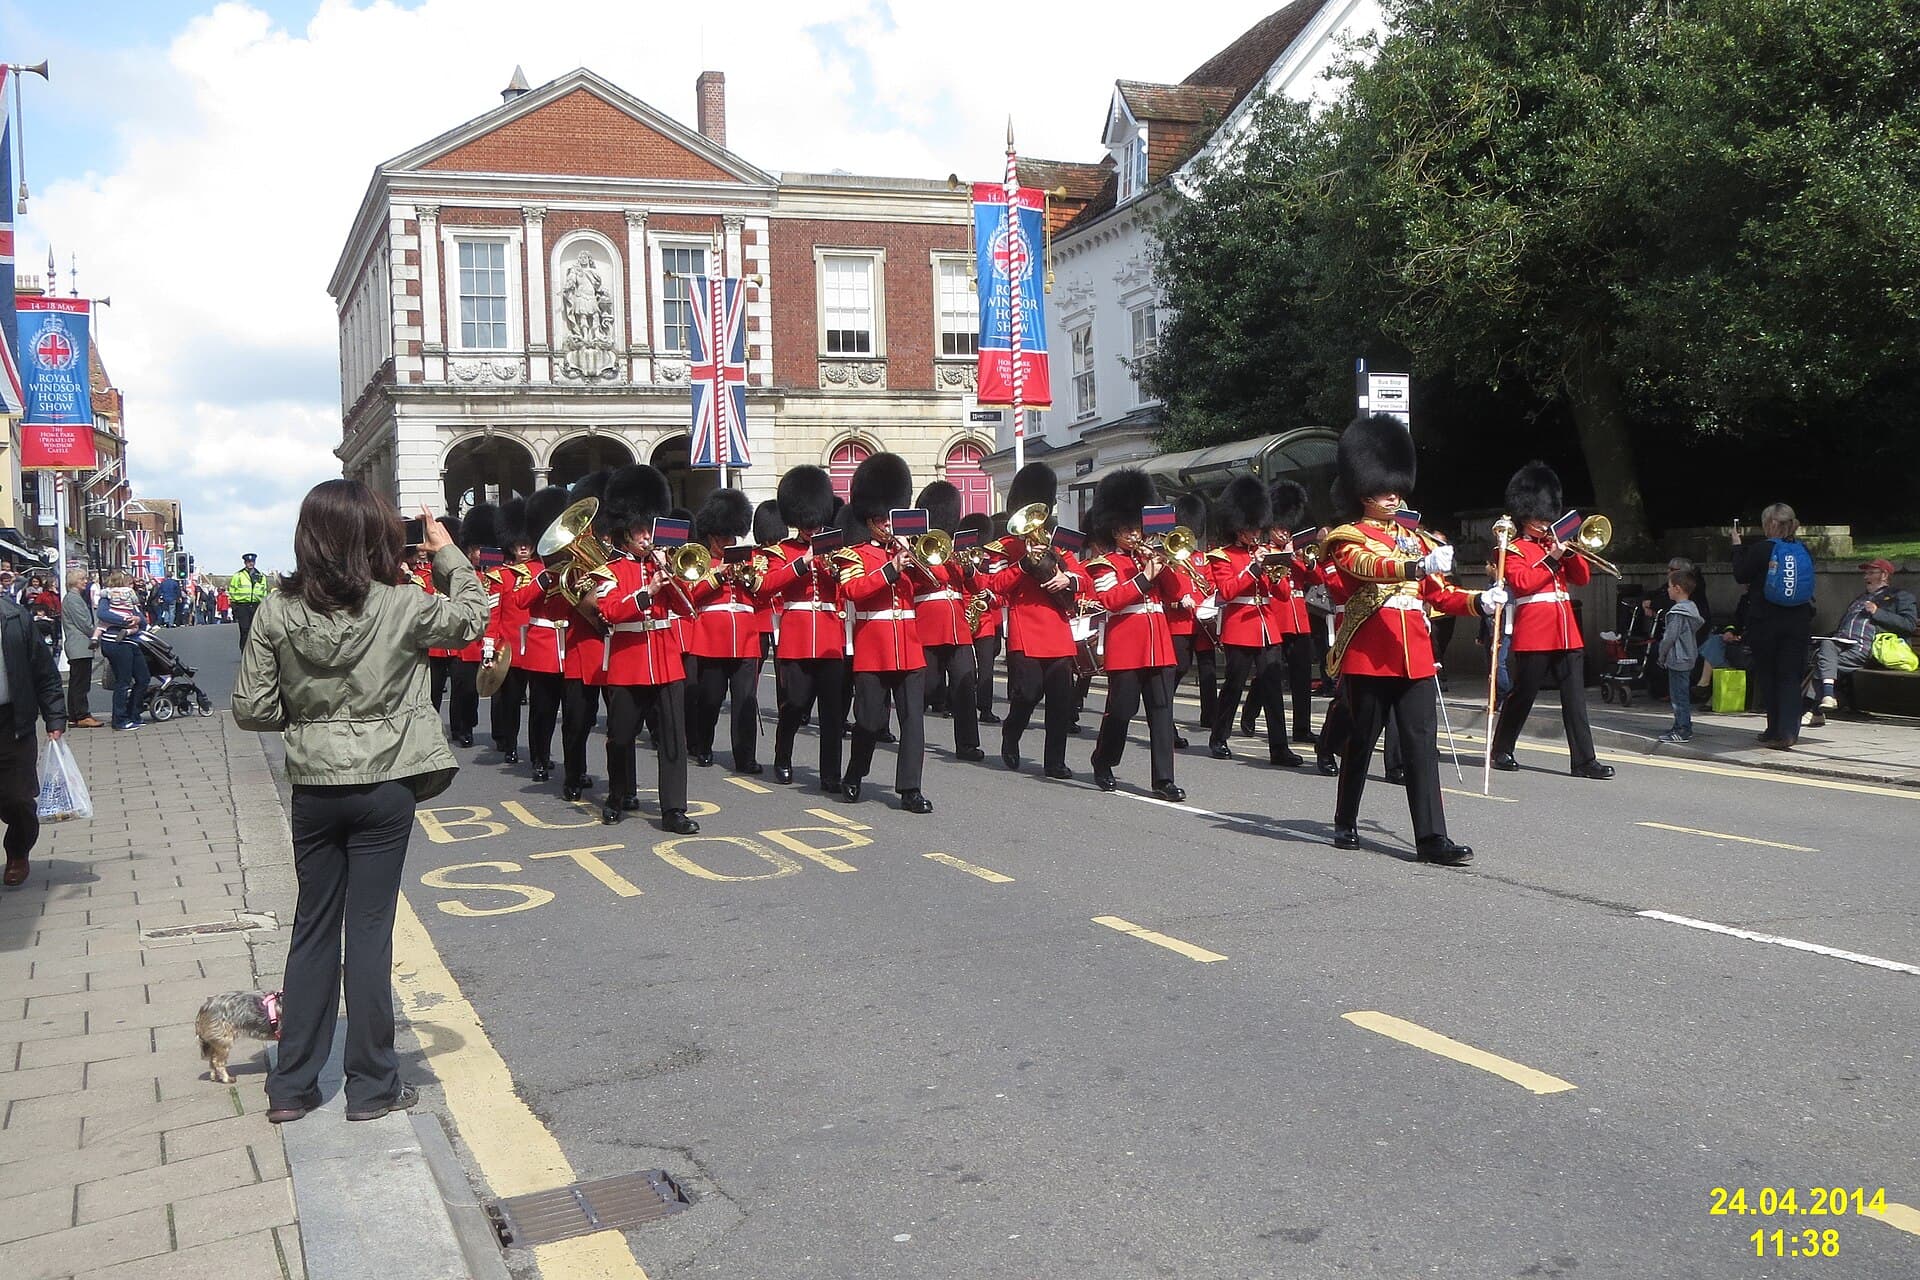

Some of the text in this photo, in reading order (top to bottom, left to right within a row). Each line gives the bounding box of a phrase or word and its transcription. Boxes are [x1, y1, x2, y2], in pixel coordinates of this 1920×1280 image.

[996, 284, 1027, 297] ROL
[31, 302, 40, 310] 14
[57, 303, 76, 311] MAY
[987, 296, 1038, 310] WINSOR
[996, 308, 1029, 321] HOSE
[996, 321, 1029, 333] SHW
[39, 373, 73, 384] ROYAL
[29, 383, 82, 393] WINDSOR
[38, 392, 75, 402] HORSE
[39, 402, 74, 412] SHOW
[1783, 555, 1795, 597] adidas
[420, 827, 874, 917] STOP
